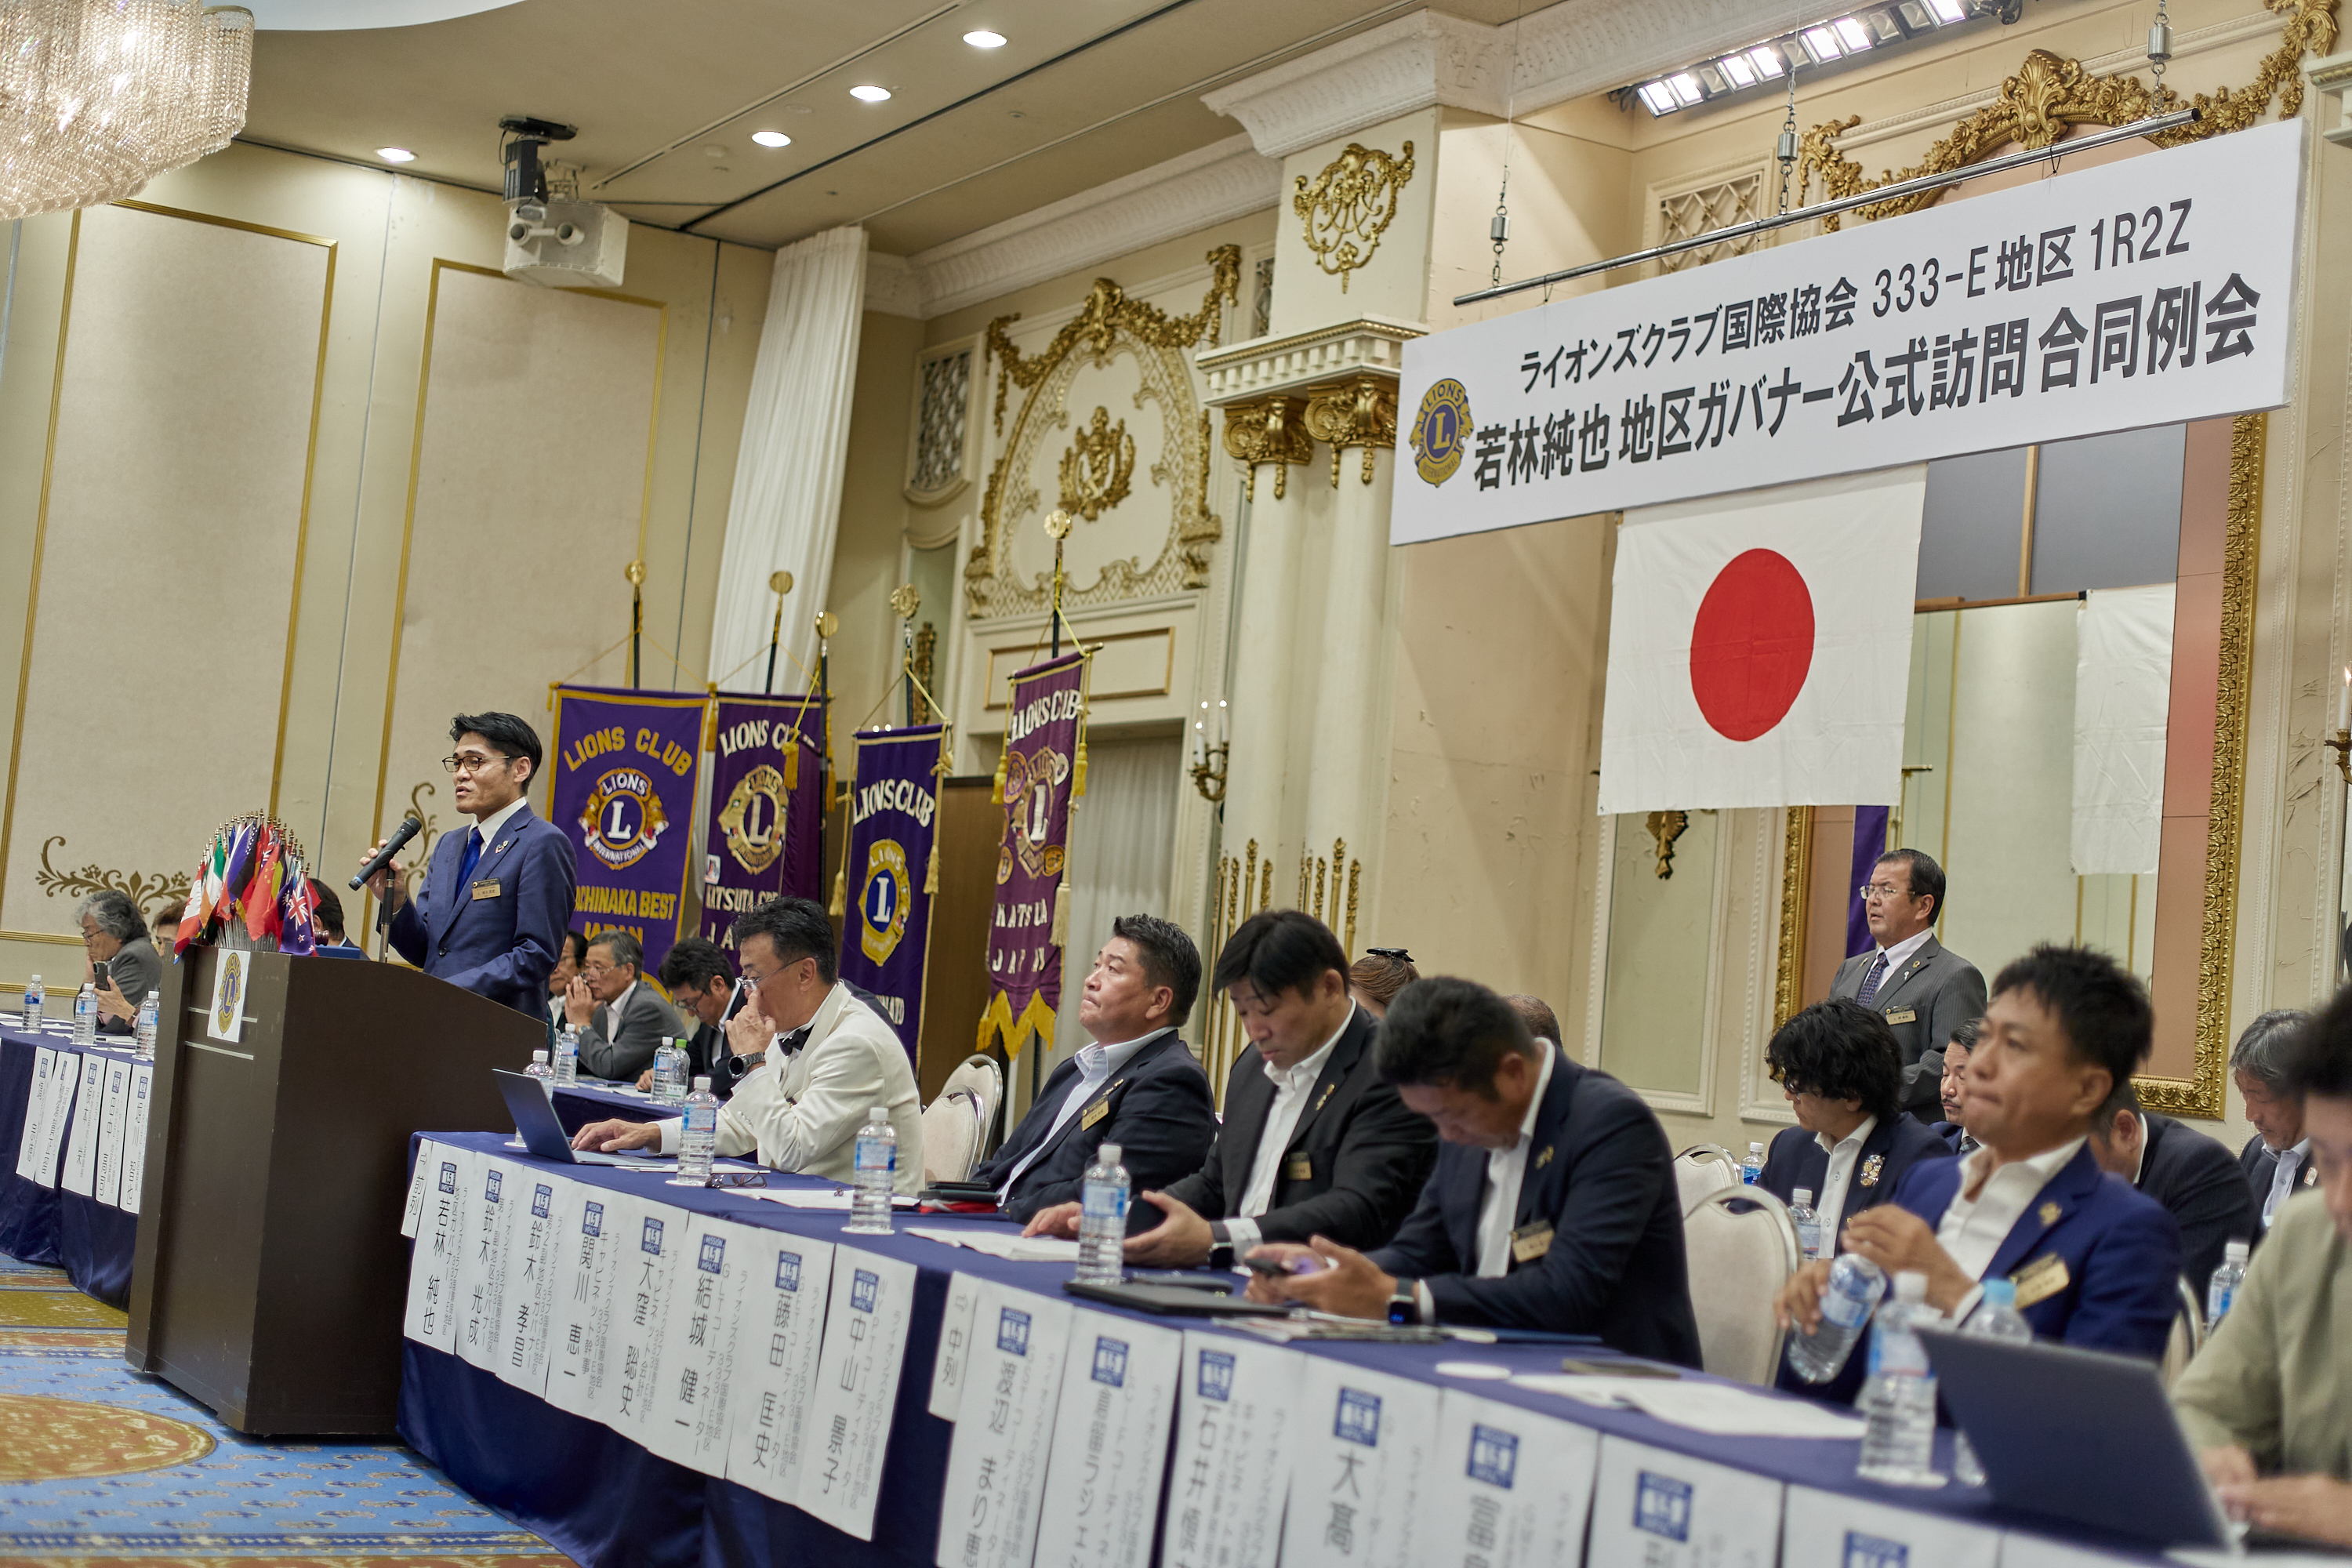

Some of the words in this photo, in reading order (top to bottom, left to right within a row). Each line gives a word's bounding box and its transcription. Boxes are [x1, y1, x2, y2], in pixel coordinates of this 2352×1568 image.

[1520, 276, 1858, 394] ライオンズクラブ国際協会
[1872, 224, 2077, 318] 333-E地区
[2089, 198, 2193, 271] 1R2Z
[1425, 383, 1462, 408] LIONS
[1433, 412, 1450, 450] L
[1473, 404, 1610, 492] 若林純也
[564, 726, 626, 772] LIONS
[635, 728, 692, 776] CLUB
[719, 719, 770, 758] LIONS
[601, 772, 648, 797] LIONS
[750, 771, 779, 793] LIONS
[607, 800, 631, 840] L
[749, 794, 772, 845] L
[1029, 784, 1049, 841] L
[593, 839, 645, 863] INTERNATIONAL
[870, 846, 902, 872] LIONS
[638, 890, 677, 920] BEST
[873, 877, 891, 923] L
[225, 978, 233, 1007] L
[443, 1162, 457, 1172] MISSION
[489, 1170, 503, 1180] MISSION
[408, 1175, 424, 1216] 前列
[536, 1184, 553, 1195] MISSION
[538, 1195, 546, 1207] 1.5
[587, 1203, 603, 1213] MISSION
[433, 1198, 450, 1258] 若林
[478, 1203, 495, 1265] 鈴木
[589, 1213, 597, 1225] 1.5
[646, 1218, 663, 1229] MISSION
[648, 1229, 657, 1243] 1.5
[523, 1220, 543, 1283] 鈴木
[705, 1235, 724, 1247] MISSION
[707, 1247, 717, 1261] 1.5
[782, 1252, 800, 1264] MISSION
[574, 1236, 595, 1304] 関川
[784, 1264, 794, 1279] 1.5
[857, 1270, 877, 1283] MISSION
[423, 1274, 441, 1335] 純也
[633, 1256, 655, 1327] 大窪
[688, 1274, 714, 1347] 結城
[467, 1283, 483, 1346] 光成
[770, 1291, 793, 1367] 藤田
[512, 1303, 530, 1367] 孝昌
[840, 1313, 866, 1392] 中山
[942, 1327, 963, 1387] 中列
[619, 1345, 640, 1417] 聡史
[675, 1367, 698, 1427] 健一
